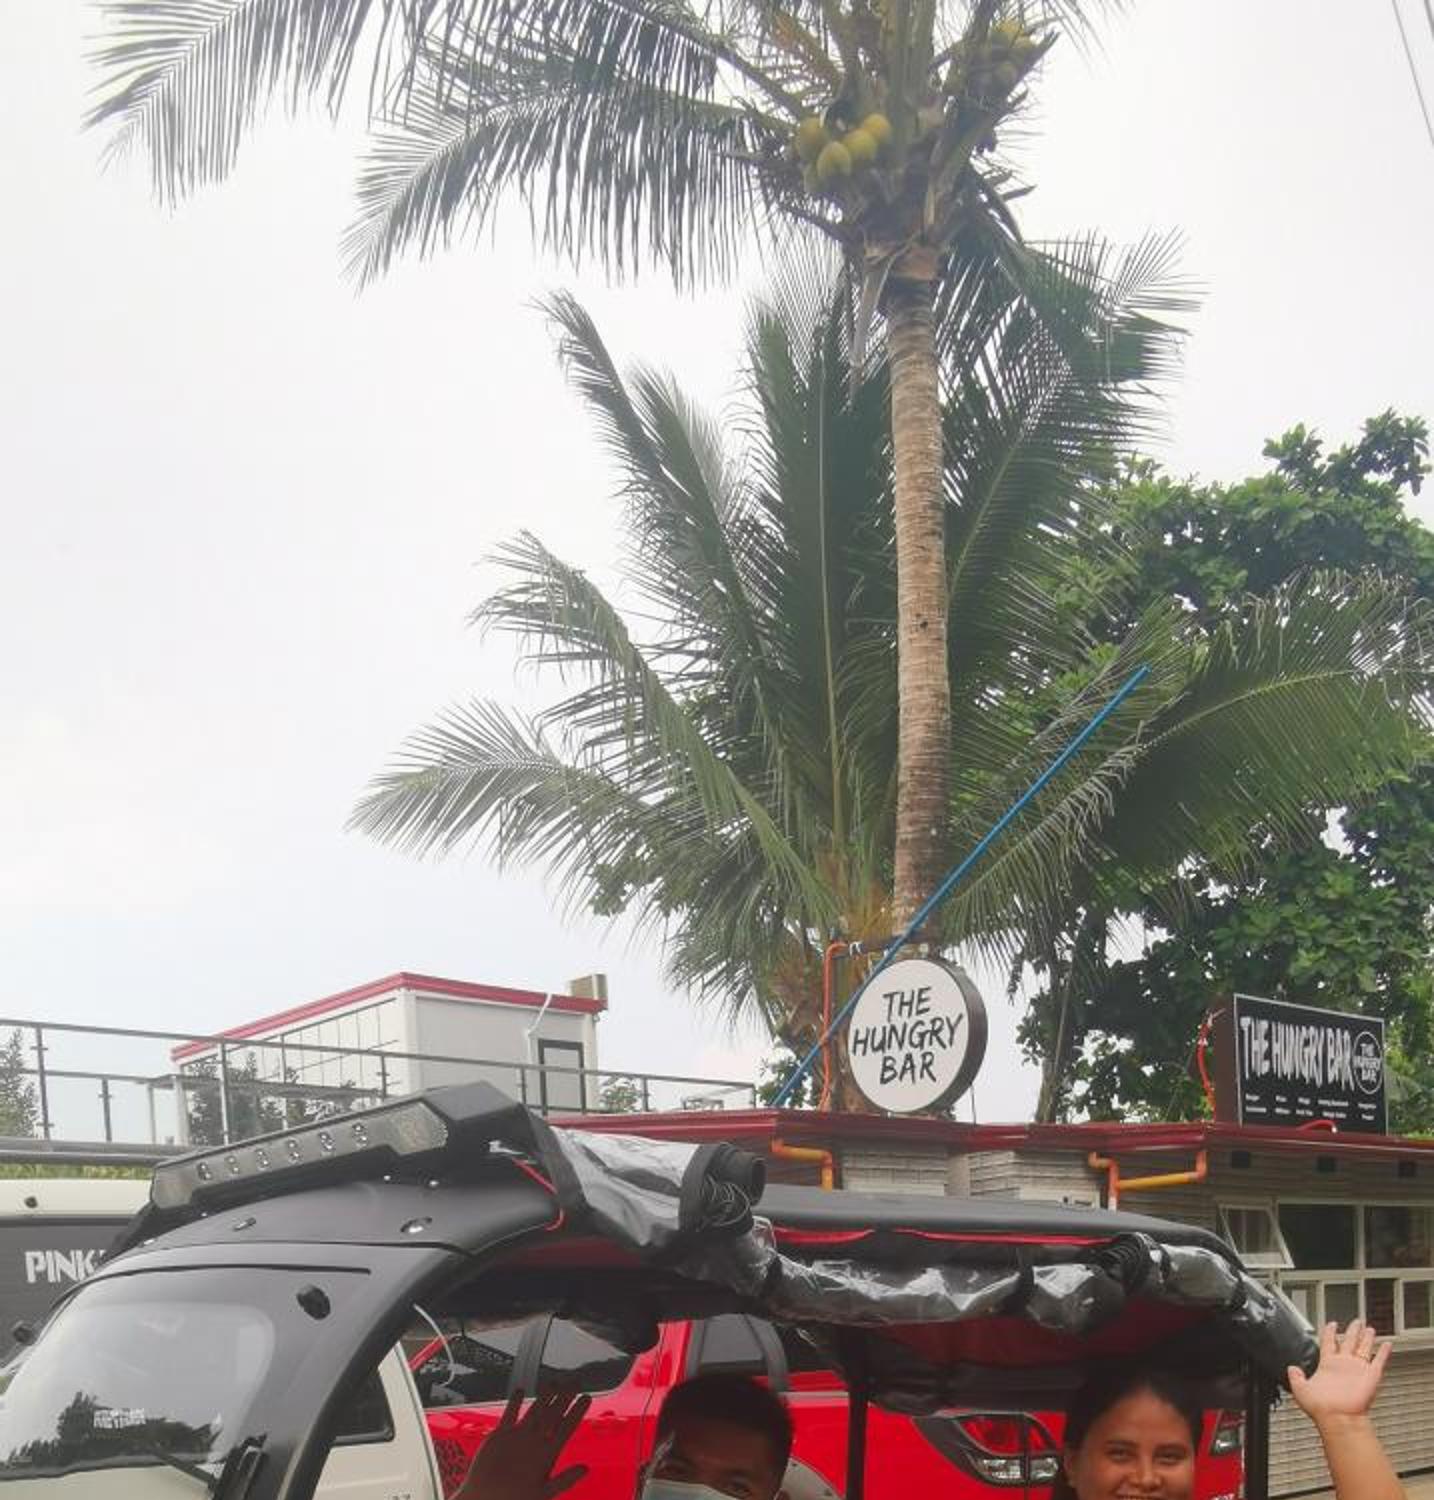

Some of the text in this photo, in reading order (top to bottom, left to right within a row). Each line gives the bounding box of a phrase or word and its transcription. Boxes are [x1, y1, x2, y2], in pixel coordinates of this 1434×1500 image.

[882, 986, 931, 1023] THE
[852, 1013, 963, 1057] HUNGRY
[1240, 1016, 1355, 1091] THE HUNGRY BAR
[880, 1051, 937, 1085] BAR
[24, 1249, 106, 1284] PINK
